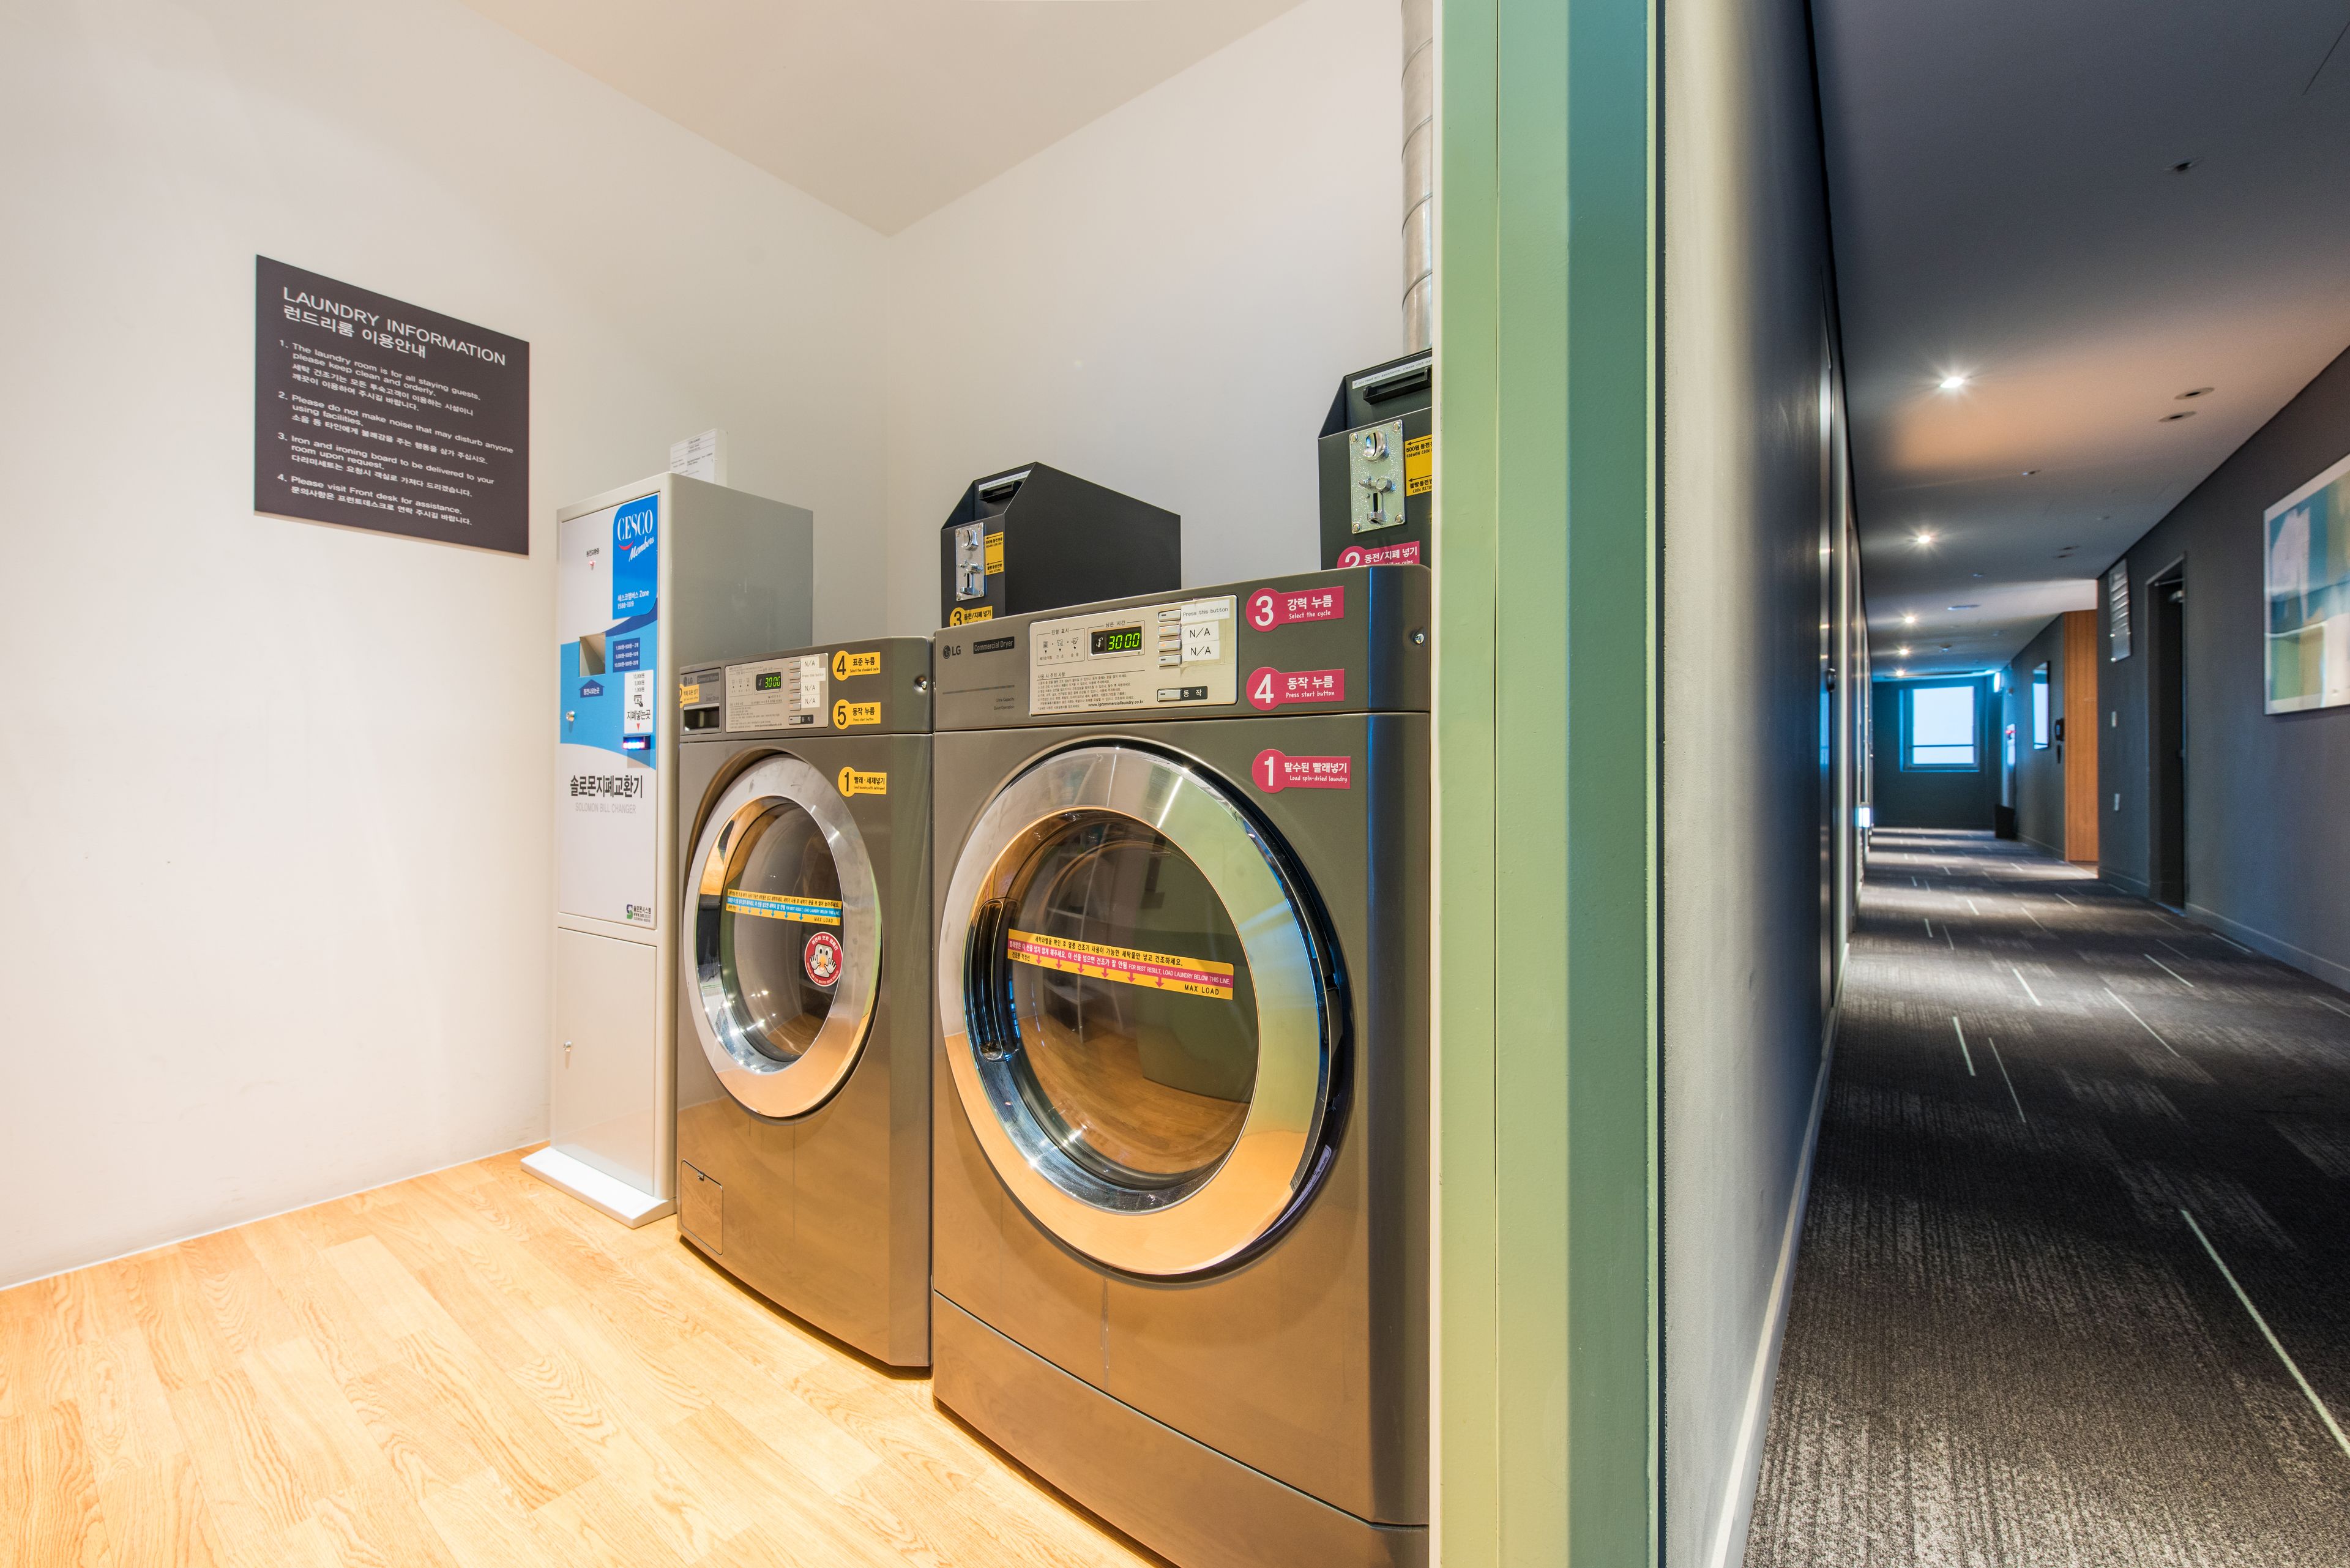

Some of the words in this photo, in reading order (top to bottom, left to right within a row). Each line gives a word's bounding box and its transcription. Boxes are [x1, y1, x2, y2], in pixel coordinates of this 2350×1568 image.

[283, 286, 379, 326] LAUNDRY
[387, 318, 505, 365] INFORMATION
[283, 305, 354, 337] 런드리룸
[362, 329, 425, 358] 이용안내
[279, 339, 288, 348] 1.
[291, 342, 311, 354] The
[315, 349, 351, 365] laundry
[354, 361, 377, 371] room
[390, 370, 403, 378] for
[418, 379, 449, 392] staying
[451, 387, 480, 400] guests.
[293, 353, 326, 366] please
[329, 361, 352, 373] keep
[355, 370, 380, 381] clean
[383, 377, 400, 386] and
[403, 383, 436, 396] orderly.
[278, 390, 288, 400] 2.
[291, 394, 325, 408] Please
[362, 413, 386, 423] make
[389, 419, 413, 429] noise
[416, 425, 431, 434] that
[435, 430, 452, 439] may
[455, 435, 483, 446] disturb
[485, 442, 513, 453] anyone
[292, 405, 319, 416] using
[323, 410, 364, 427] facilities.
[277, 431, 288, 441] 3.
[291, 435, 310, 445] Iron
[313, 441, 332, 450] and
[335, 444, 367, 458] ironing
[370, 452, 397, 464] board
[425, 465, 463, 478] delivered
[291, 445, 316, 455] room
[319, 451, 344, 461] upon
[347, 457, 384, 469] request.
[277, 473, 287, 482] 4.
[291, 476, 324, 488] Please
[327, 483, 346, 492] visit
[349, 487, 373, 498] Front
[376, 493, 398, 502] desk
[415, 501, 461, 514] assistance.
[617, 509, 653, 540] CESCO
[629, 537, 654, 562] Members
[1364, 549, 1400, 563] 동전/지폐
[1402, 546, 1417, 557] 넣기
[1345, 552, 1360, 567] 2
[1255, 595, 1274, 626] 3
[1287, 597, 1307, 611] 강력
[1311, 594, 1332, 608] 누름
[954, 611, 961, 625] 3
[963, 611, 982, 620] 동전/지폐
[1190, 628, 1210, 638] N/A
[952, 646, 961, 656] LG
[974, 641, 999, 651] Commercial
[1190, 646, 1211, 656] N/A
[837, 655, 846, 675] 4
[852, 657, 863, 666] 표준
[864, 657, 875, 665] 누름
[1255, 674, 1274, 703] 4
[1287, 676, 1308, 690] 동작
[1311, 675, 1334, 688] 누름
[627, 709, 651, 720] 지폐넣는곳
[838, 706, 846, 725] 5
[852, 707, 863, 715] 동작
[864, 706, 875, 715] 누름
[1264, 756, 1274, 786] 1
[1284, 762, 1309, 772] 탈수된
[1313, 763, 1346, 773] 빨래넣기
[570, 775, 642, 798] 솔로몬지폐교환기
[575, 802, 599, 812] SOLOMON
[600, 803, 610, 813] BILL
[611, 803, 636, 813] CHANGER
